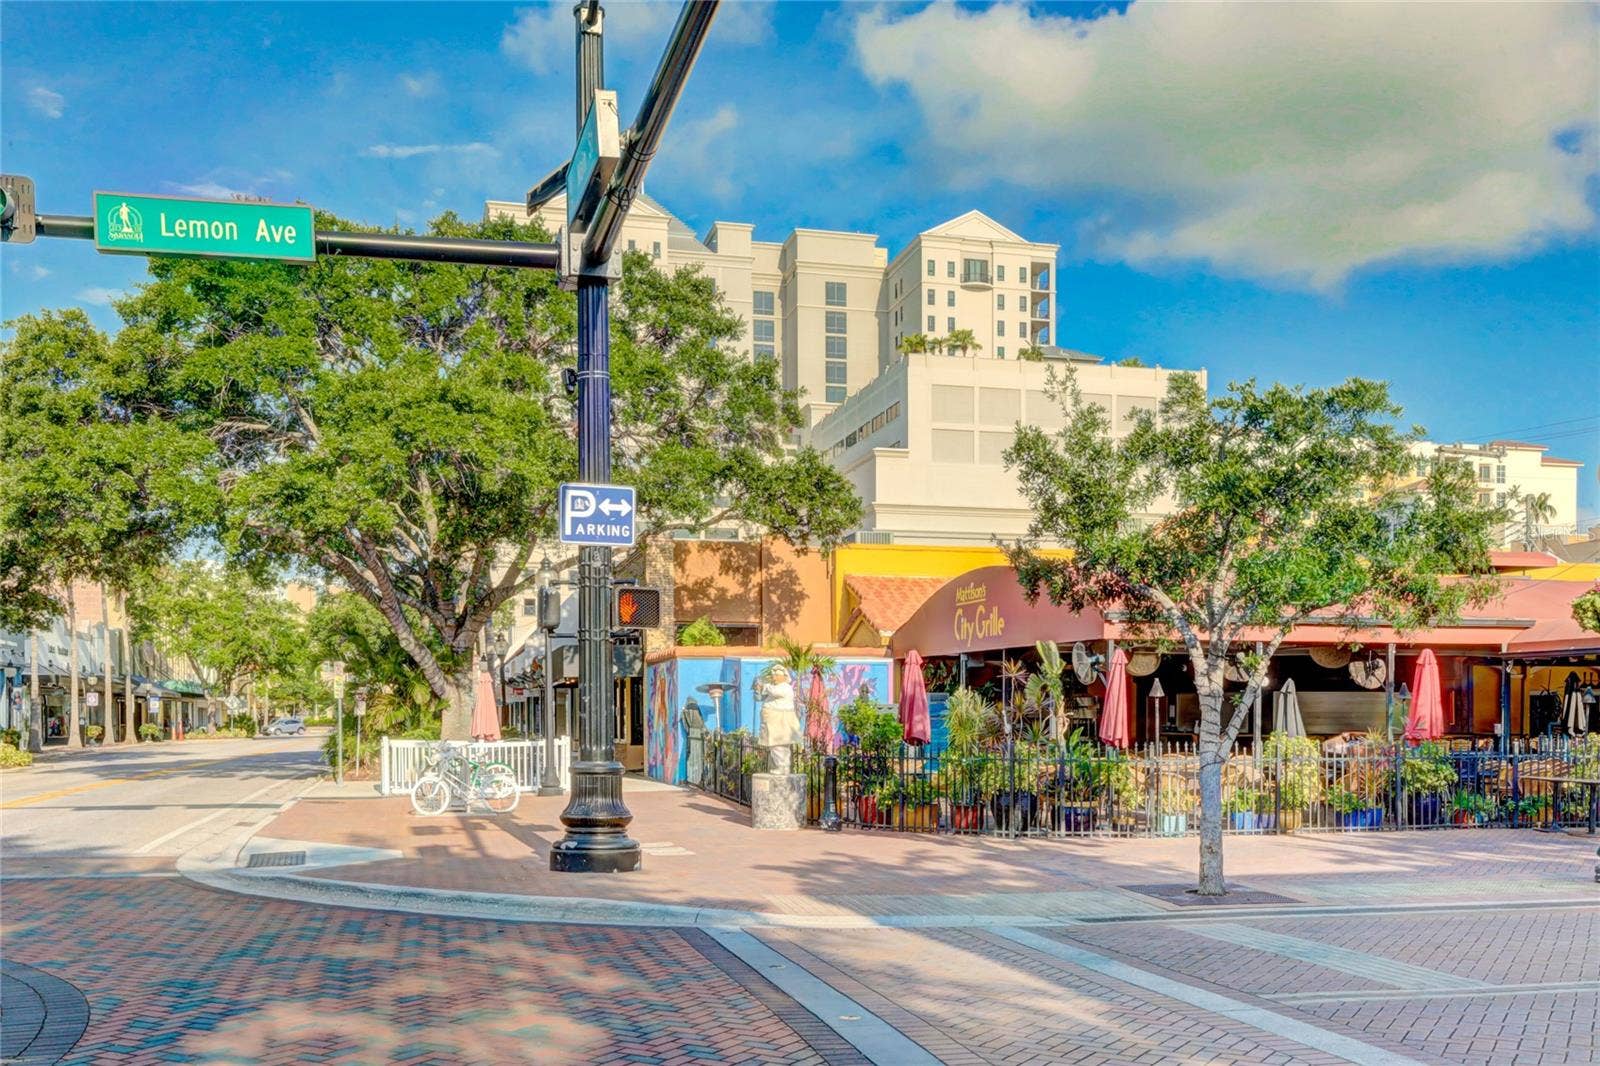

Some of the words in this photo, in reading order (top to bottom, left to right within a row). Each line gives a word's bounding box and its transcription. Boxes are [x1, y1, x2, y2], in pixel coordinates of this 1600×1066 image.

[160, 213, 238, 240] Lemon
[255, 219, 297, 244] Ave
[954, 607, 975, 647] City
[975, 604, 1005, 640] Grille
